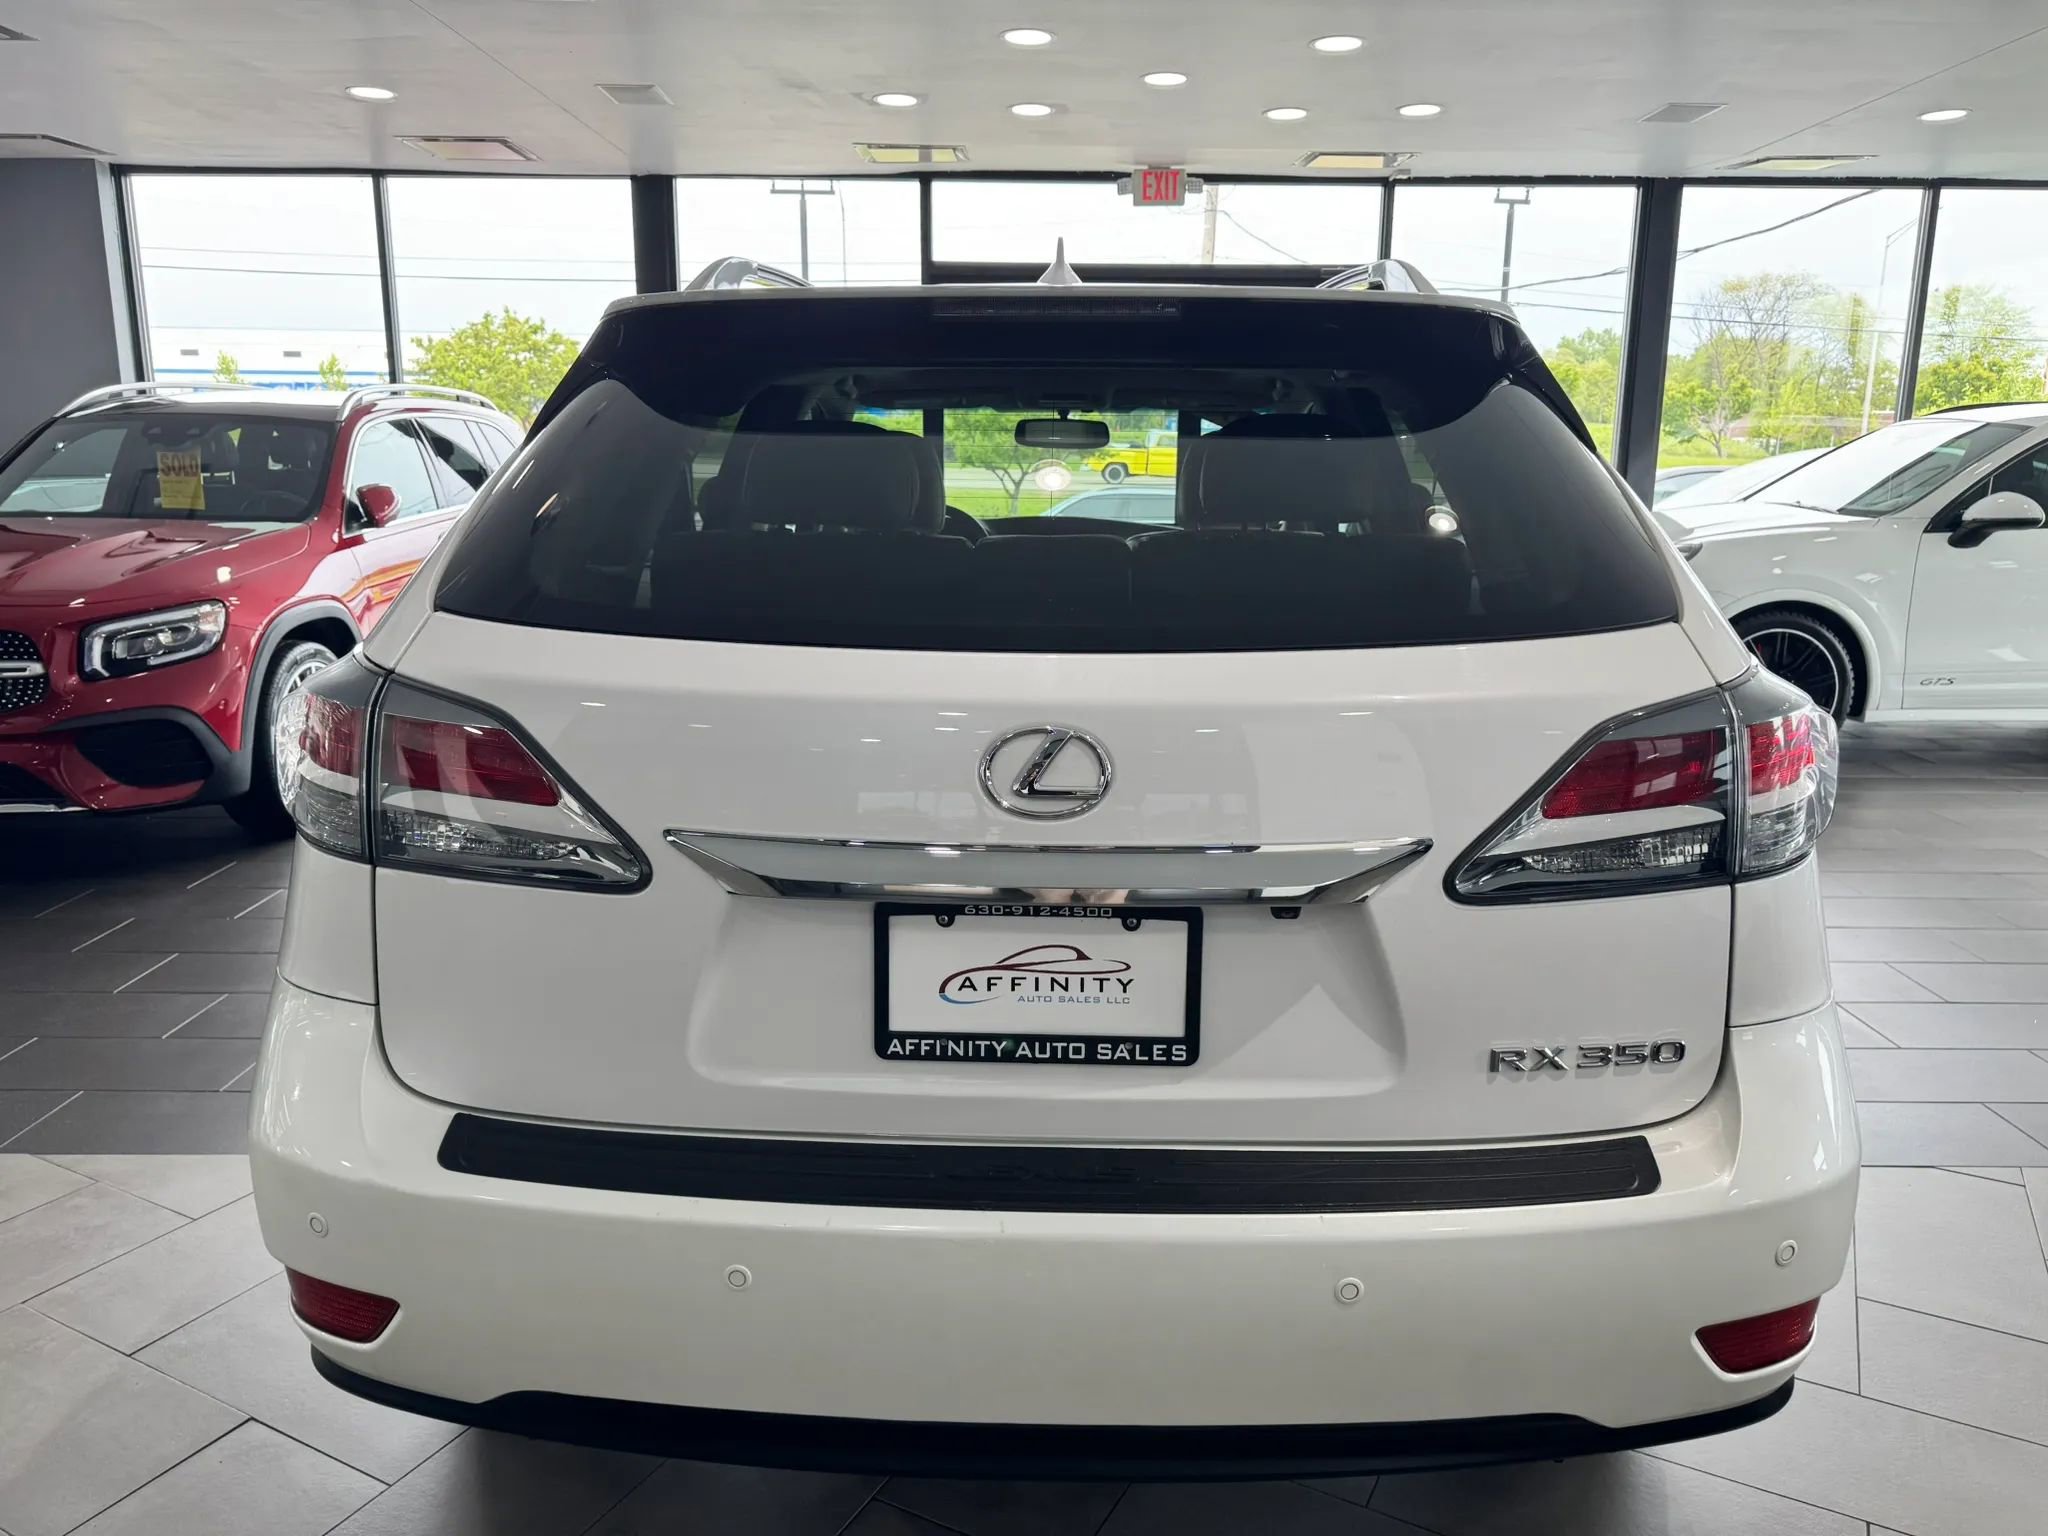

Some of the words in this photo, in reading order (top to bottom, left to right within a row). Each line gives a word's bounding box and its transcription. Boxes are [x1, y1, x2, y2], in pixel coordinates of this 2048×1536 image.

[1142, 171, 1180, 202] EXIT
[160, 453, 200, 477] SOLD
[1919, 677, 1957, 687] GTS
[964, 904, 1113, 918] 630-912-4500
[957, 976, 1135, 994] AFFINITY
[1017, 995, 1052, 1004] AUTO
[1058, 996, 1101, 1005] SALES
[1106, 996, 1131, 1005] LLC
[886, 1038, 1009, 1058] AFFINITY
[1015, 1041, 1086, 1060] AUTO
[1096, 1043, 1187, 1062] SALES
[1489, 1045, 1570, 1073] RX
[1576, 1039, 1687, 1069] 350
